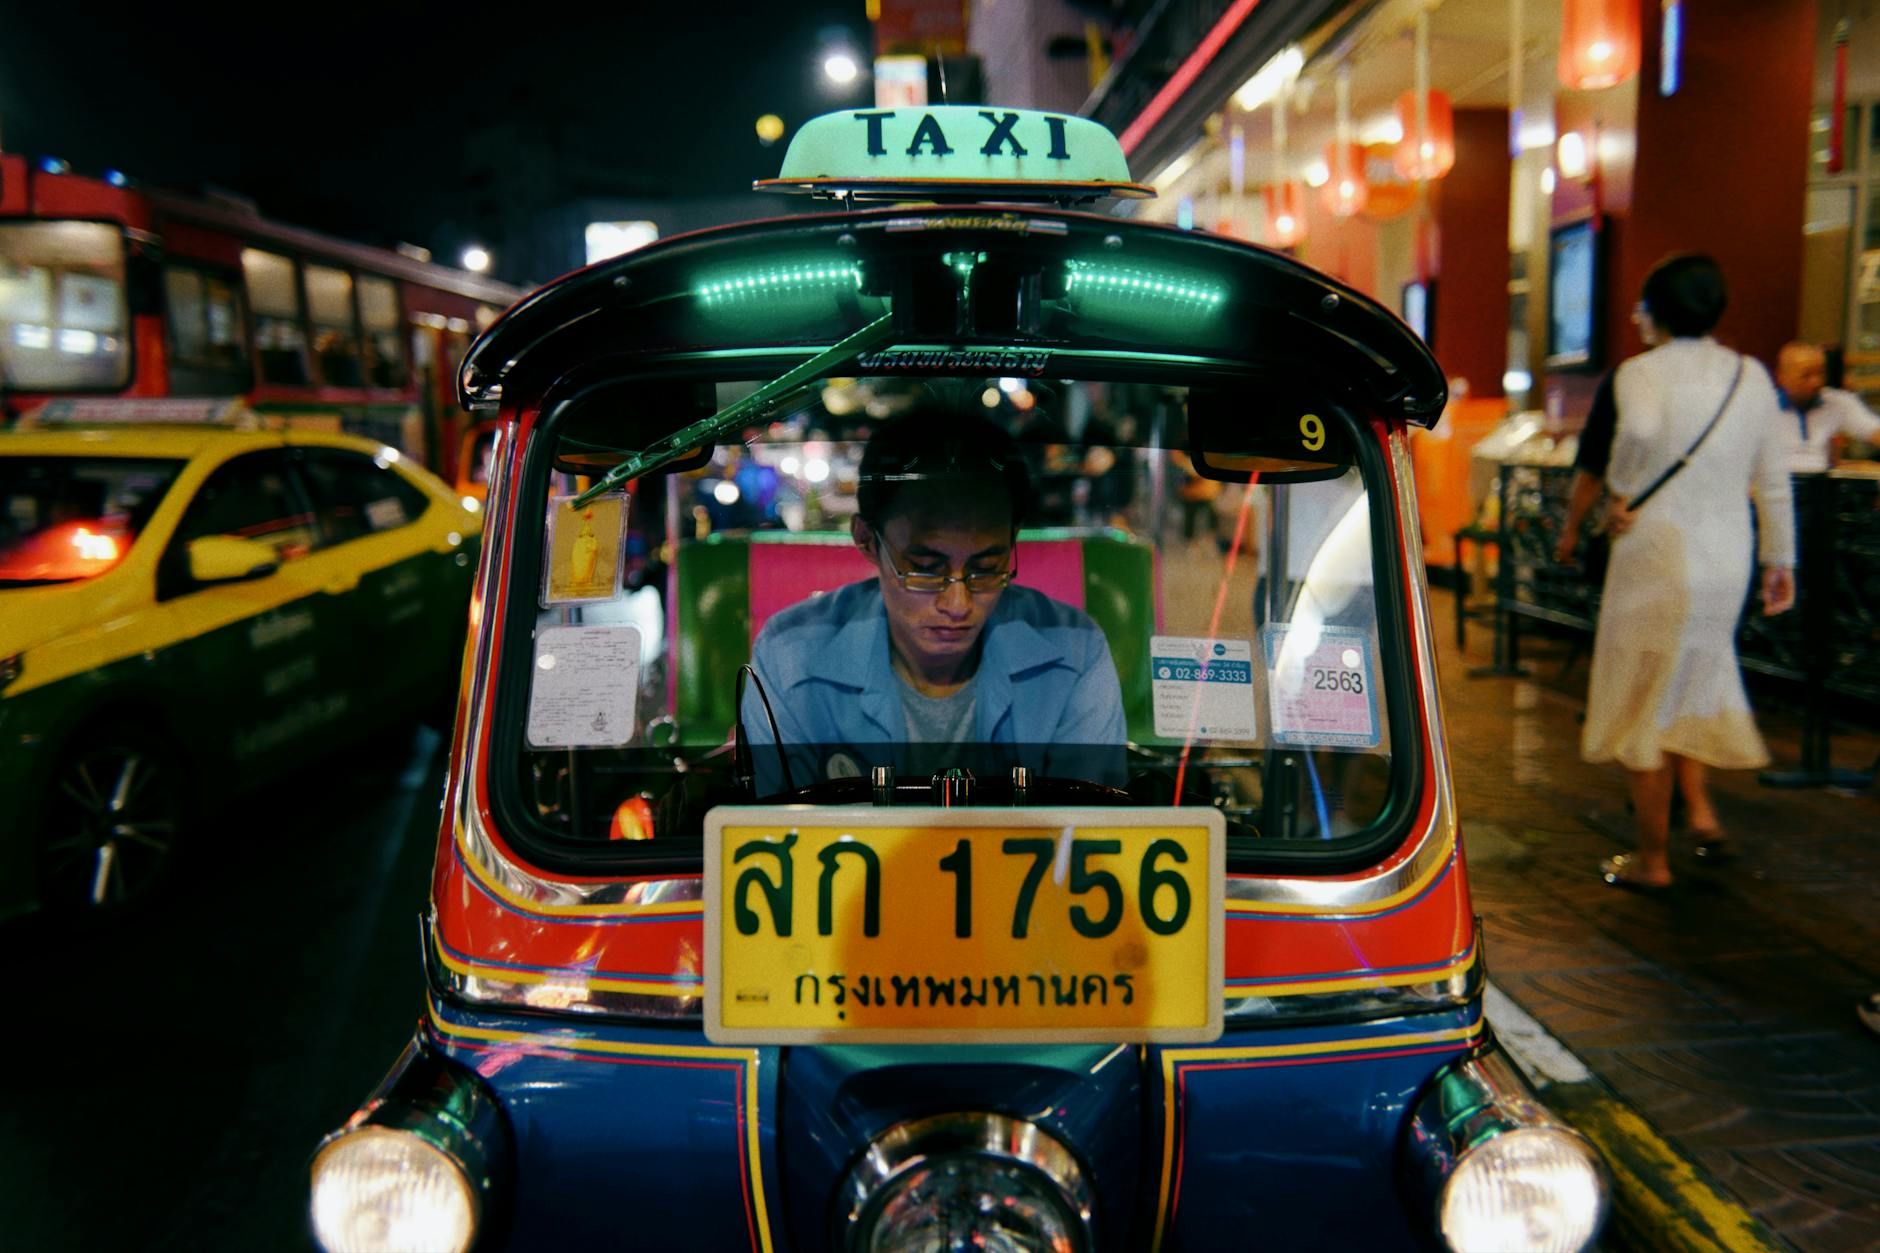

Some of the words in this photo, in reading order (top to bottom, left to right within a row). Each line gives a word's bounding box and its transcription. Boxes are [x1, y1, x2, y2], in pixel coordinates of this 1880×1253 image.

[853, 111, 1070, 160] TAXI
[1299, 414, 1327, 452] 9
[1175, 667, 1247, 682] 02-869-3333
[1314, 669, 1364, 694] 2563
[733, 828, 881, 938] สก
[939, 837, 1191, 939] 1756
[794, 970, 1135, 1020] กรุงเทพมหานคร
